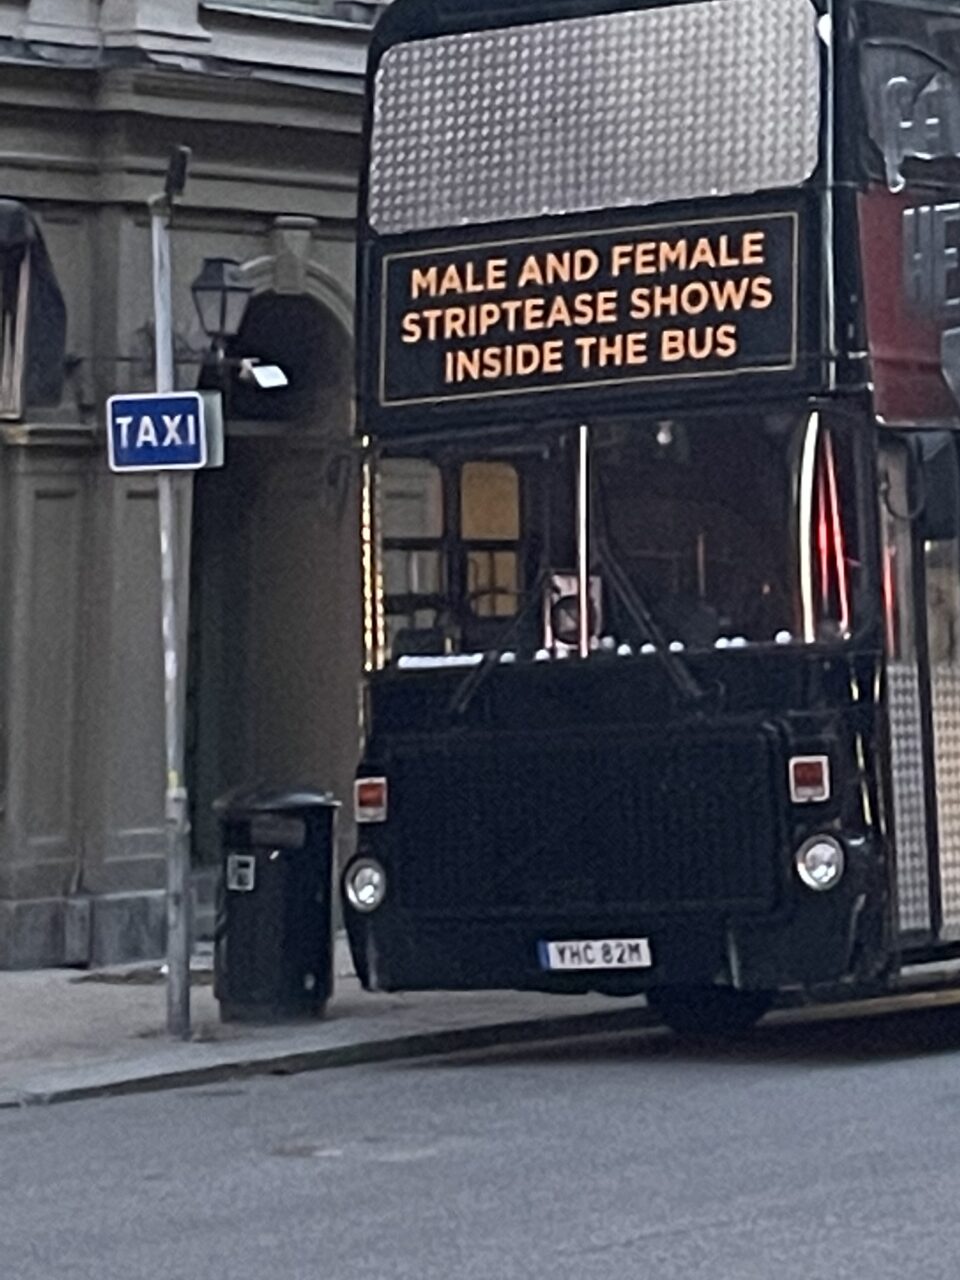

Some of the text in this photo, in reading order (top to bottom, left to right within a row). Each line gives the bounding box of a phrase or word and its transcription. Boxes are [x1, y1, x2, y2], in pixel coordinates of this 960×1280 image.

[411, 232, 765, 298] MALE AND FEMALE
[401, 277, 773, 343] STRIPTEASE SHOWS
[445, 325, 737, 383] INSIDE THE BUS
[115, 414, 196, 448] TAXI
